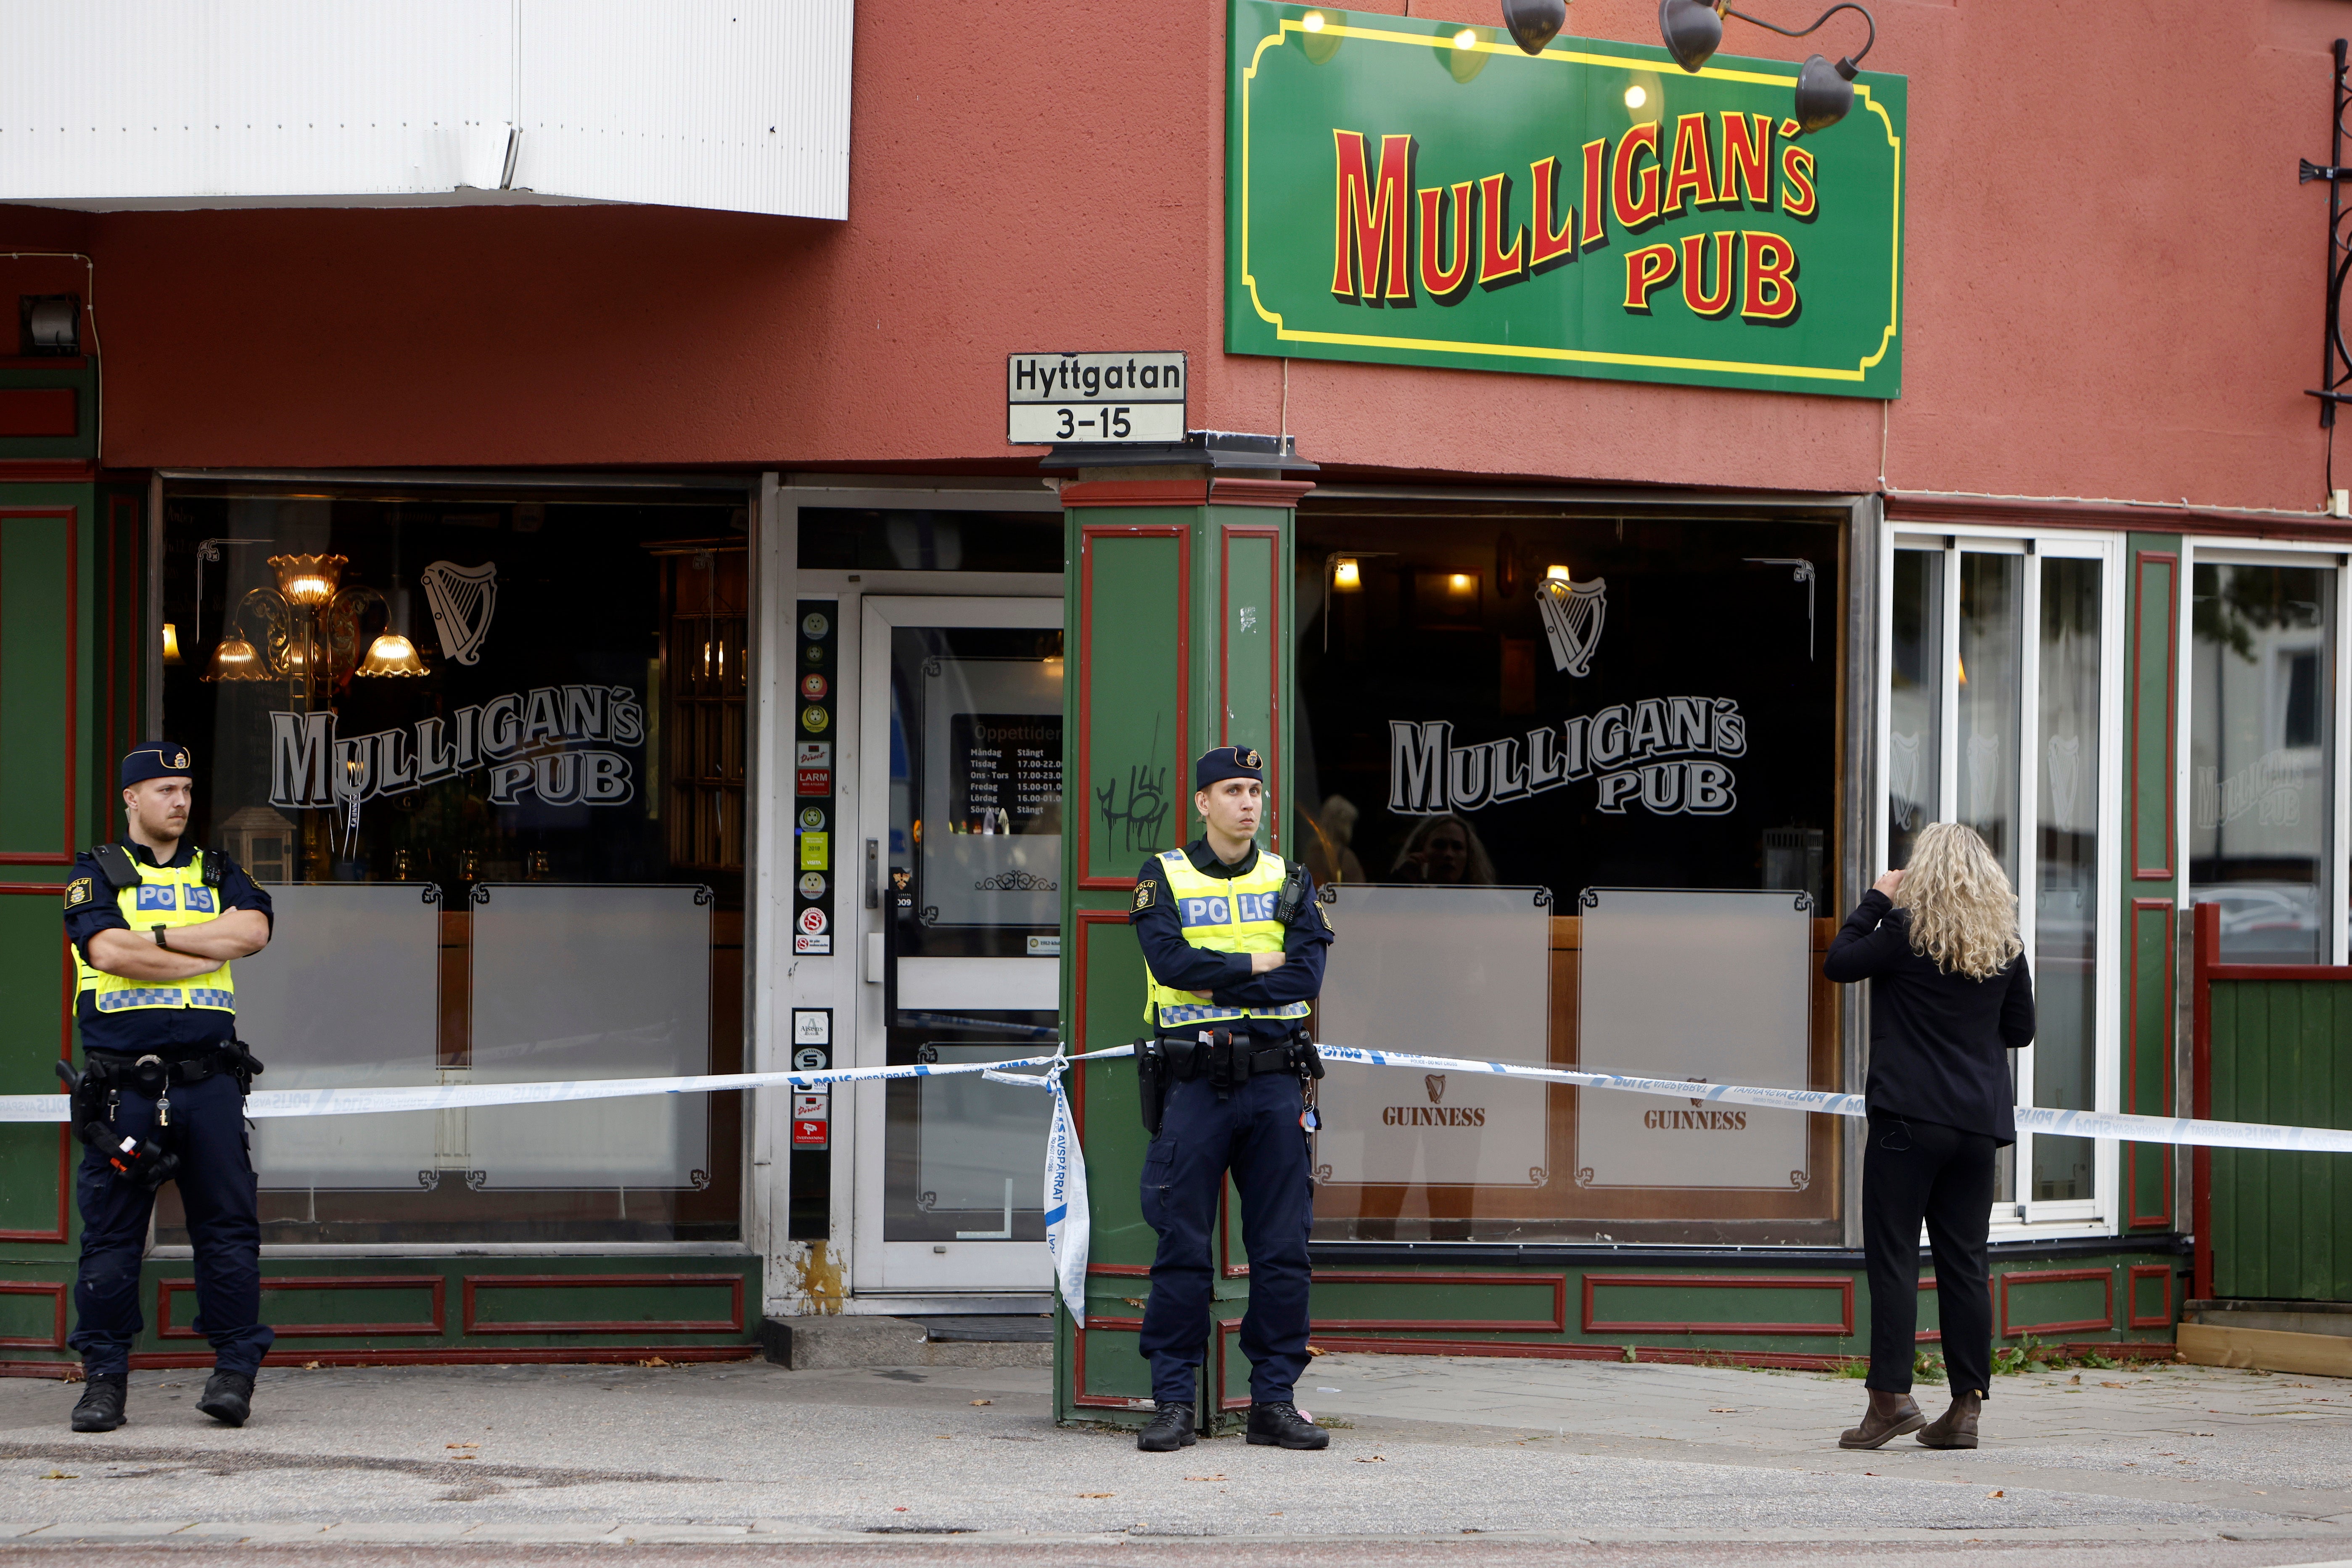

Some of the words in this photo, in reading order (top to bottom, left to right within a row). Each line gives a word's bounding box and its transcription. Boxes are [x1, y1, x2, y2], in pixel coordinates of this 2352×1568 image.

[1624, 230, 1801, 326] PUB
[1017, 358, 1180, 398] Hyttgatan
[1056, 407, 1131, 439] 3-15
[975, 722, 1062, 743] Öppettider
[970, 748, 1002, 757] Måndag
[1017, 748, 1044, 758] Stängt
[970, 760, 997, 769] Tisdag
[487, 750, 635, 806] PUB
[800, 773, 827, 782] LARM
[970, 783, 998, 792] Fredag
[1595, 759, 1737, 815] PUB
[970, 794, 997, 803] Lördag
[2258, 787, 2300, 827] PUB
[970, 806, 1000, 814] Söndag
[1017, 806, 1044, 815] Stängt
[68, 879, 89, 891] POLIS
[1135, 882, 1155, 894] POLIS
[140, 886, 211, 909] POLIS
[1189, 893, 1275, 924] POLIS
[1382, 1106, 1485, 1126] GUINNESS
[1644, 1110, 1747, 1130] GUINNESS
[1052, 1135, 1067, 1202] AVSPÄRRAT
